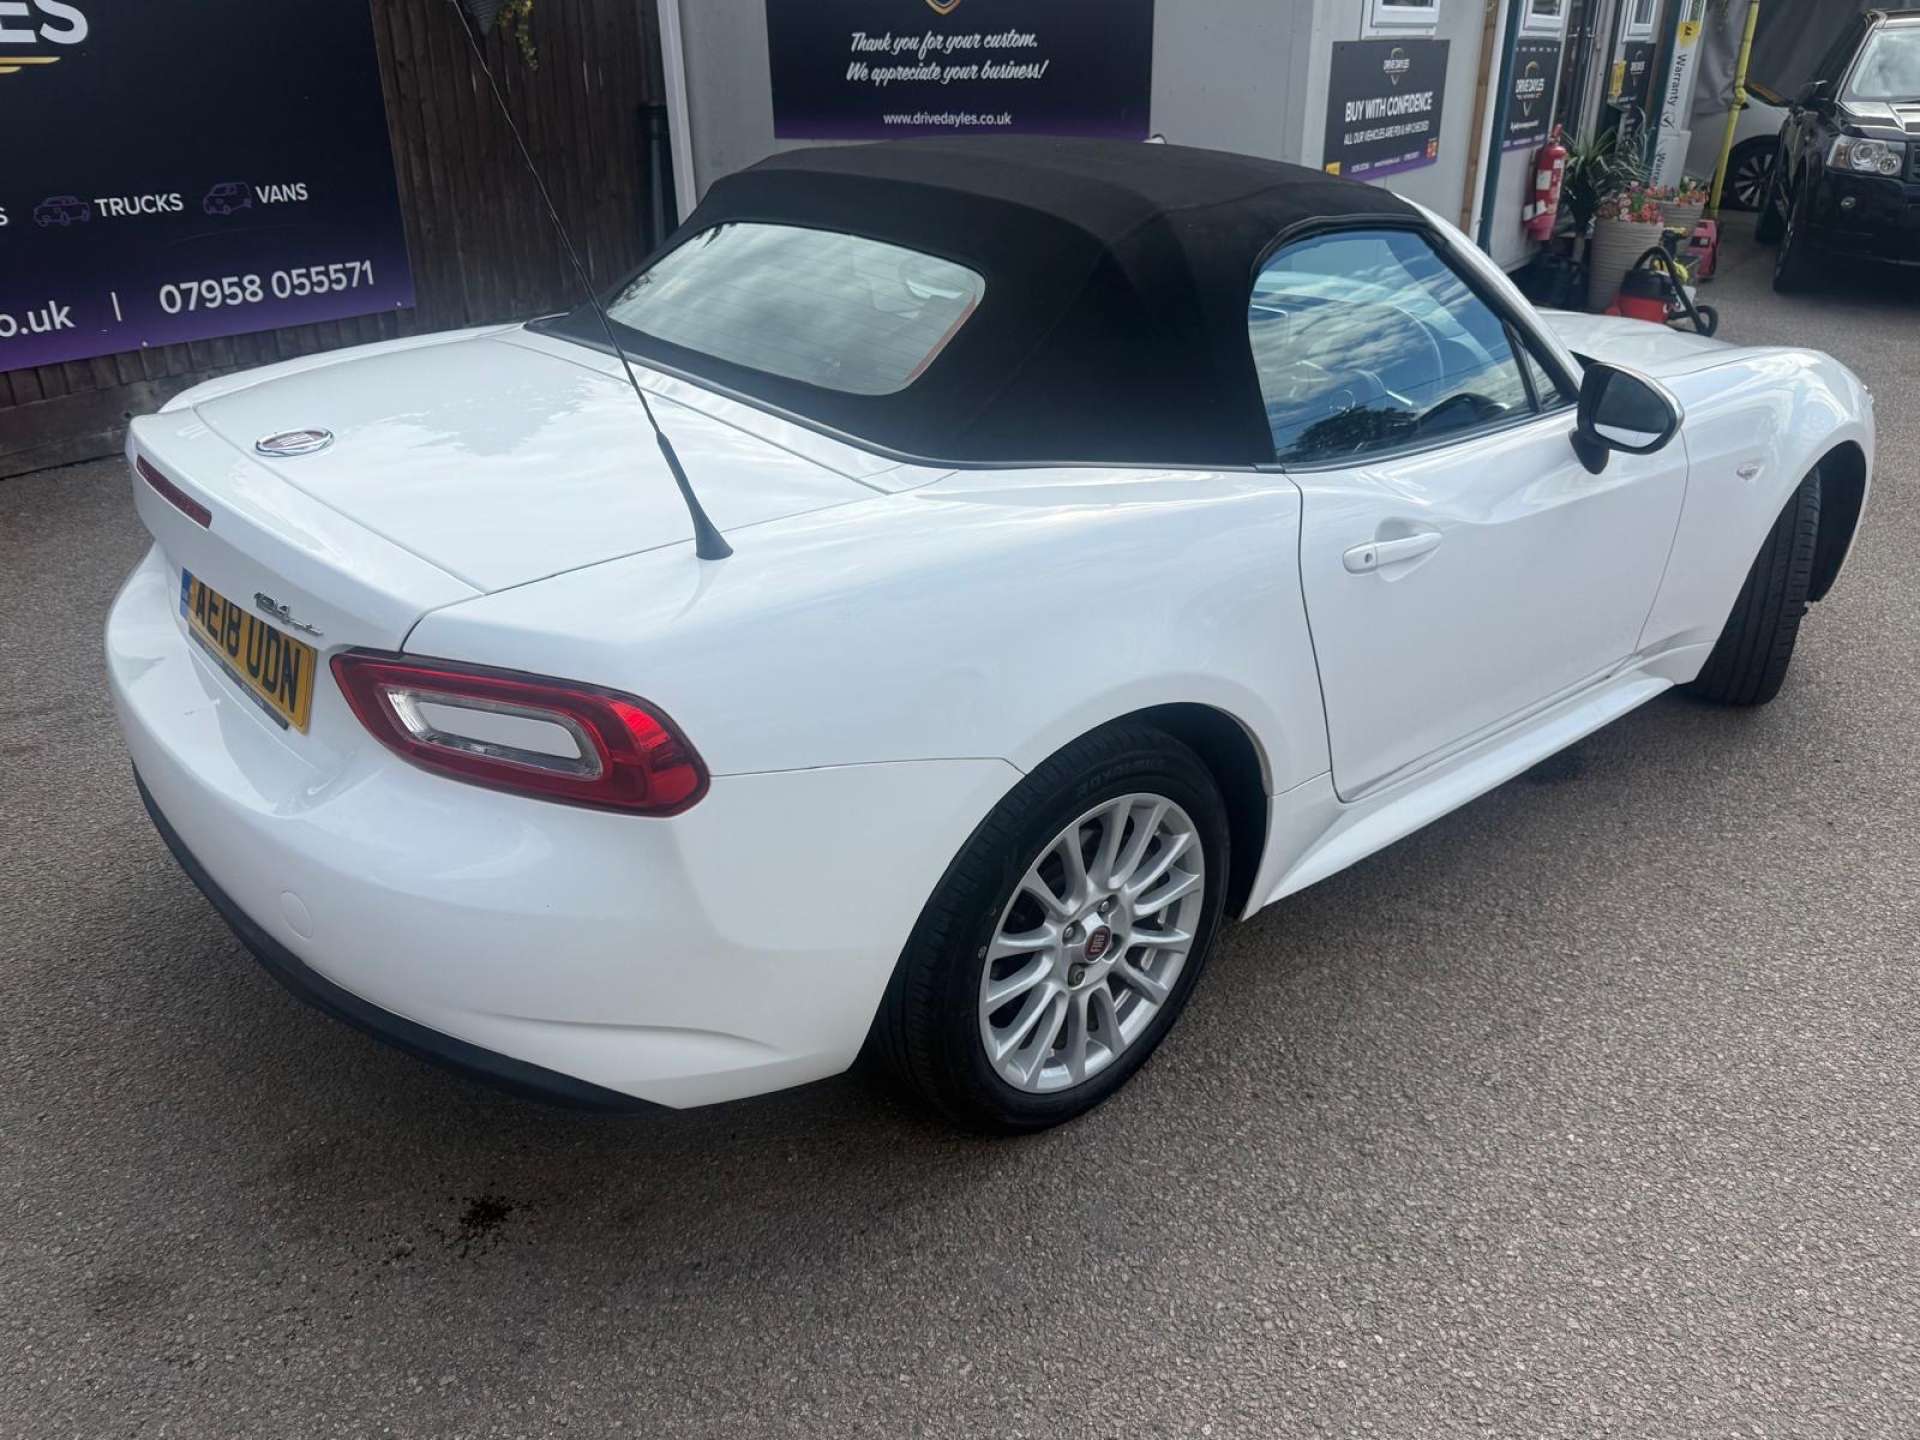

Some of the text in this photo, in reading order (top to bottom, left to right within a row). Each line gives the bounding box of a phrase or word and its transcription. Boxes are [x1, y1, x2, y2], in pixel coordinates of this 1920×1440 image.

[851, 28, 1038, 60] Thank you for your custom.
[846, 59, 1049, 87] We appreciate your business!
[1668, 54, 1688, 106] Warranty
[883, 111, 1012, 127] www.drivedayles.co.uk
[1345, 91, 1433, 122] BUY WITH CONFIDENCE
[95, 183, 308, 218] TRUCKS VANS
[159, 274, 264, 314] 07958
[271, 260, 374, 299] 055571
[196, 582, 242, 658] AE18
[247, 615, 301, 714] UDN
